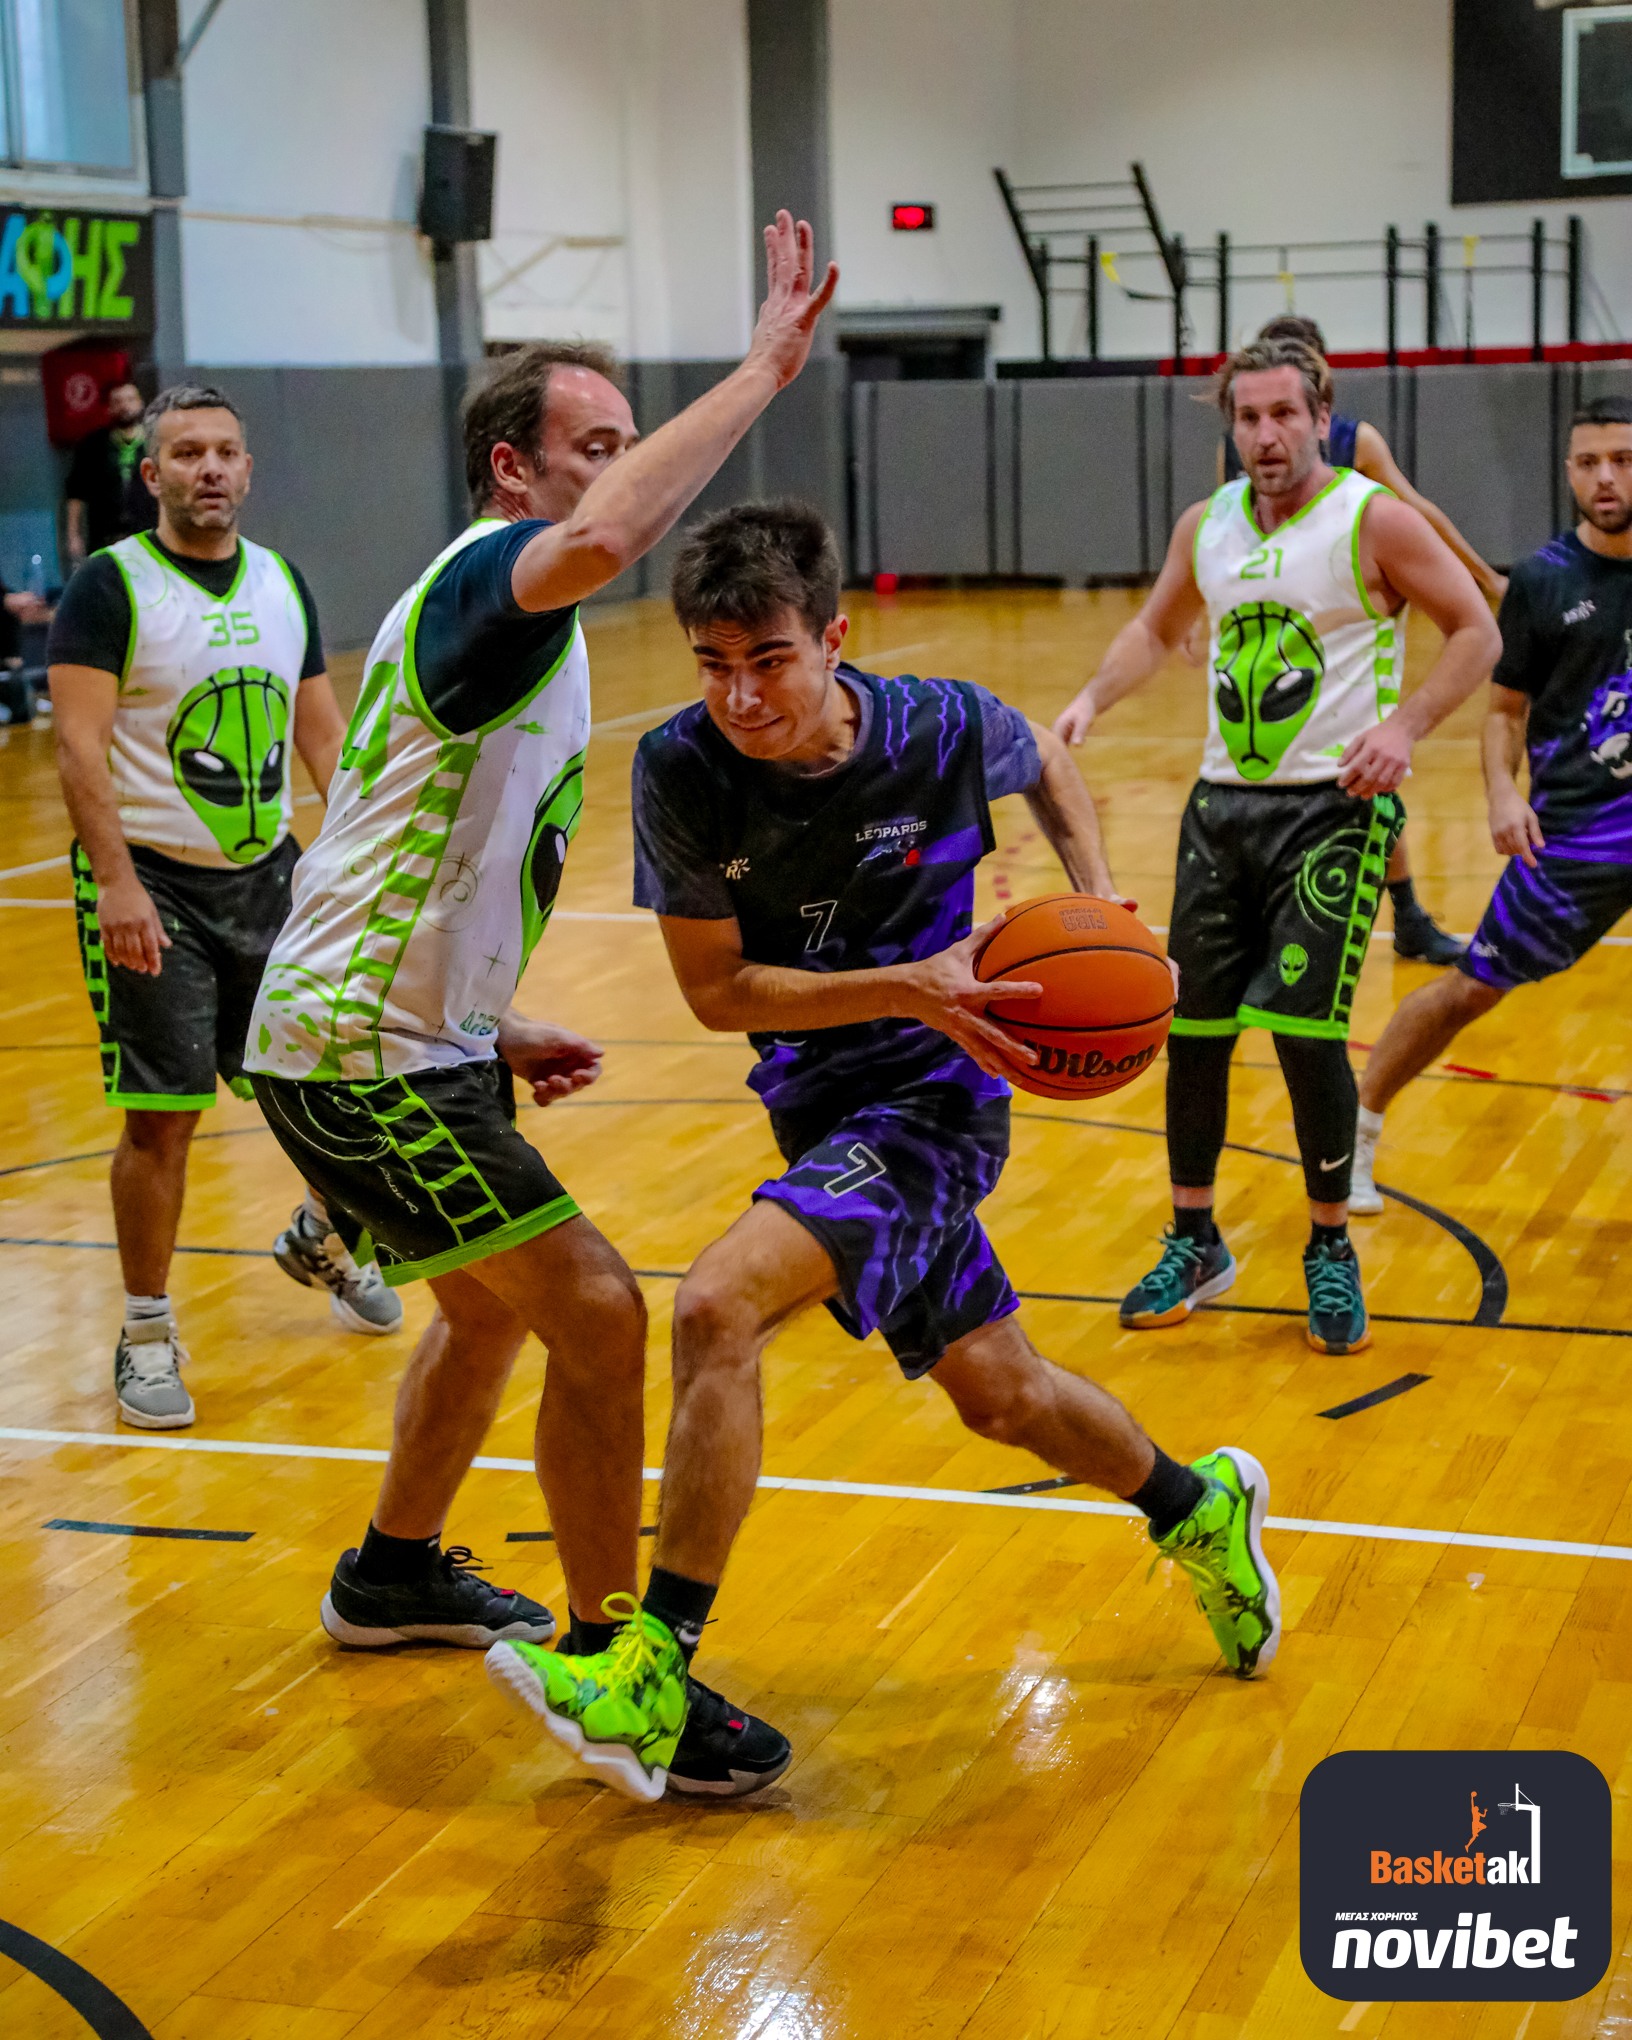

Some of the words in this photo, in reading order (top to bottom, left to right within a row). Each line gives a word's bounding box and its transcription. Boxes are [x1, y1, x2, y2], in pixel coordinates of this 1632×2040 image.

[1239, 547, 1283, 580] 21
[201, 611, 260, 648] 35
[800, 899, 838, 953] 7
[1062, 914, 1107, 932] FIBA
[1023, 1038, 1155, 1078] Wilson
[823, 1142, 887, 1199] 7
